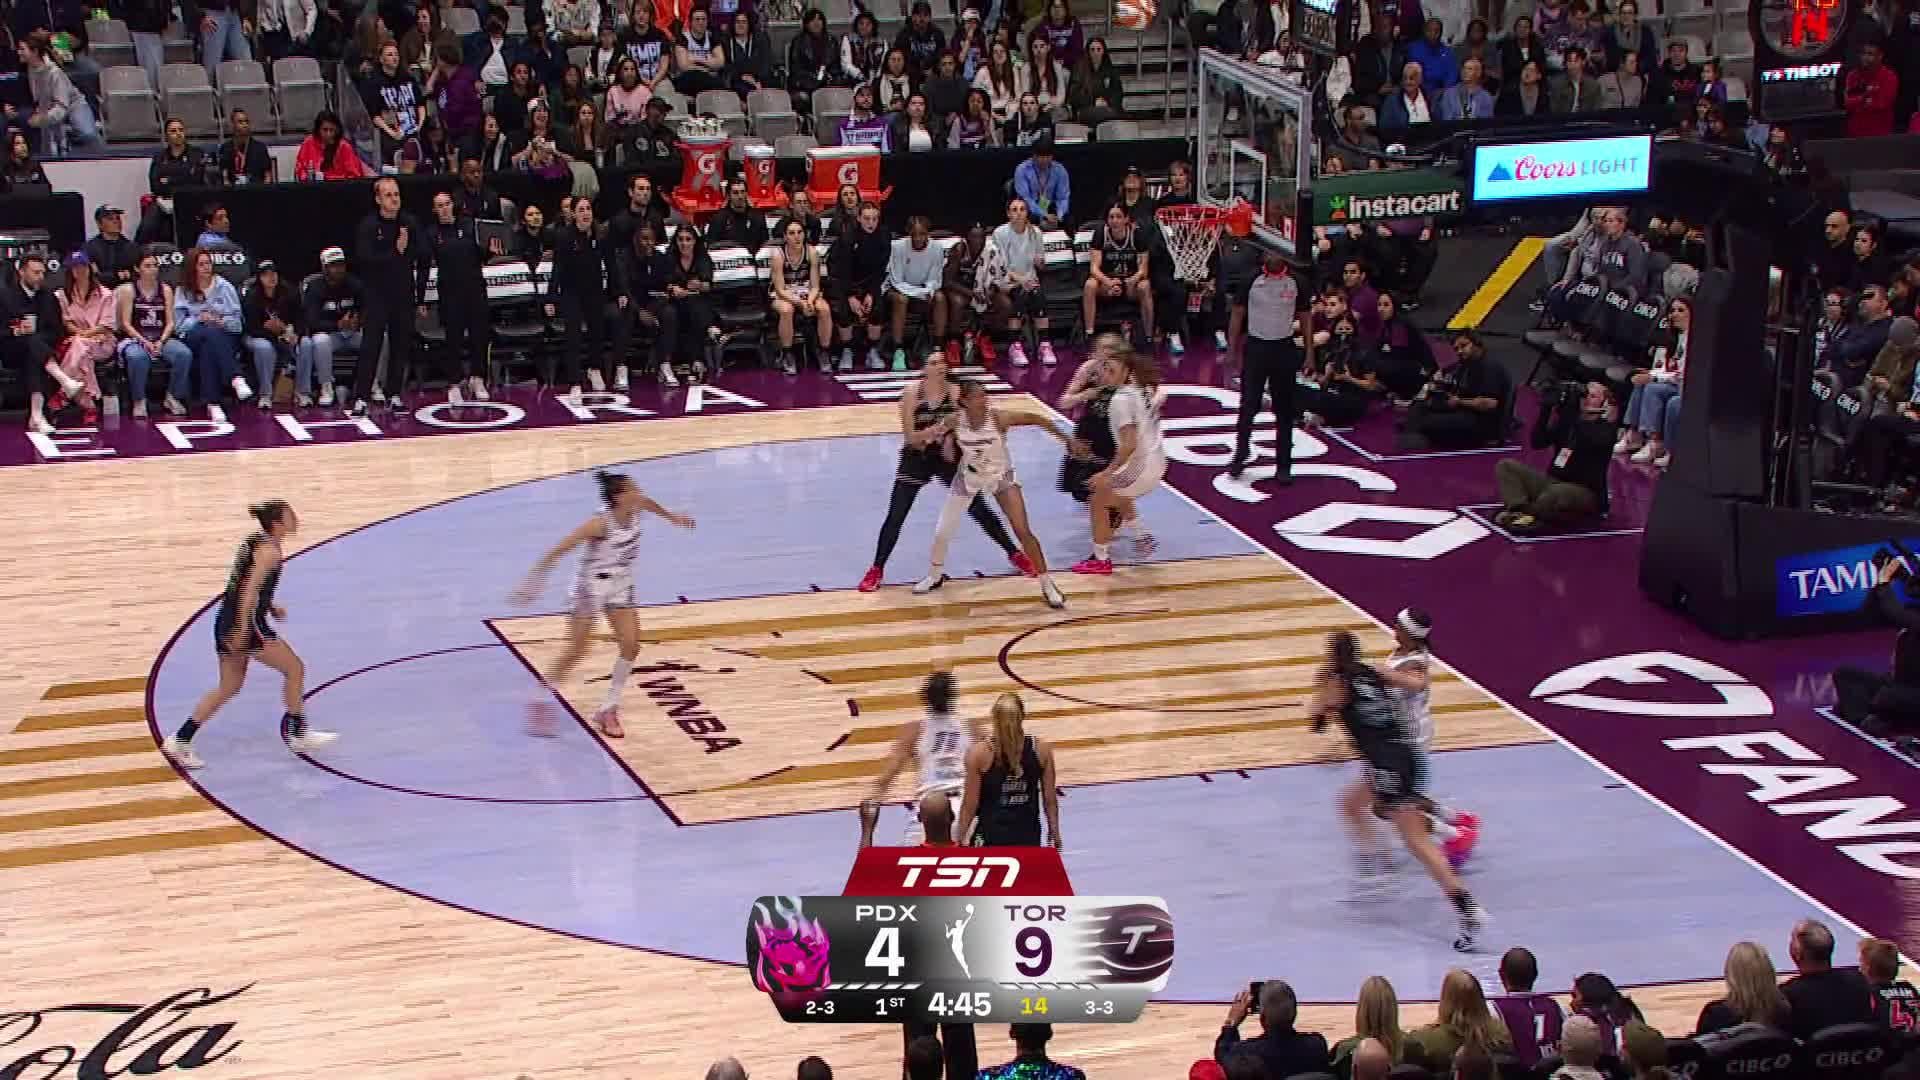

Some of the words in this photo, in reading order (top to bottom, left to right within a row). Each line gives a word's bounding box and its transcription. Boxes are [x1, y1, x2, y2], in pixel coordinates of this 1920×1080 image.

[1784, 62, 1842, 80] TISSOT
[697, 153, 717, 175] G
[757, 159, 771, 174] G
[836, 161, 858, 184] G
[1515, 155, 1577, 181] Coors
[1580, 157, 1639, 175] LIGHT
[1349, 189, 1461, 220] instacart
[638, 676, 743, 754] WNBA
[1533, 1014, 1546, 1041] 1
